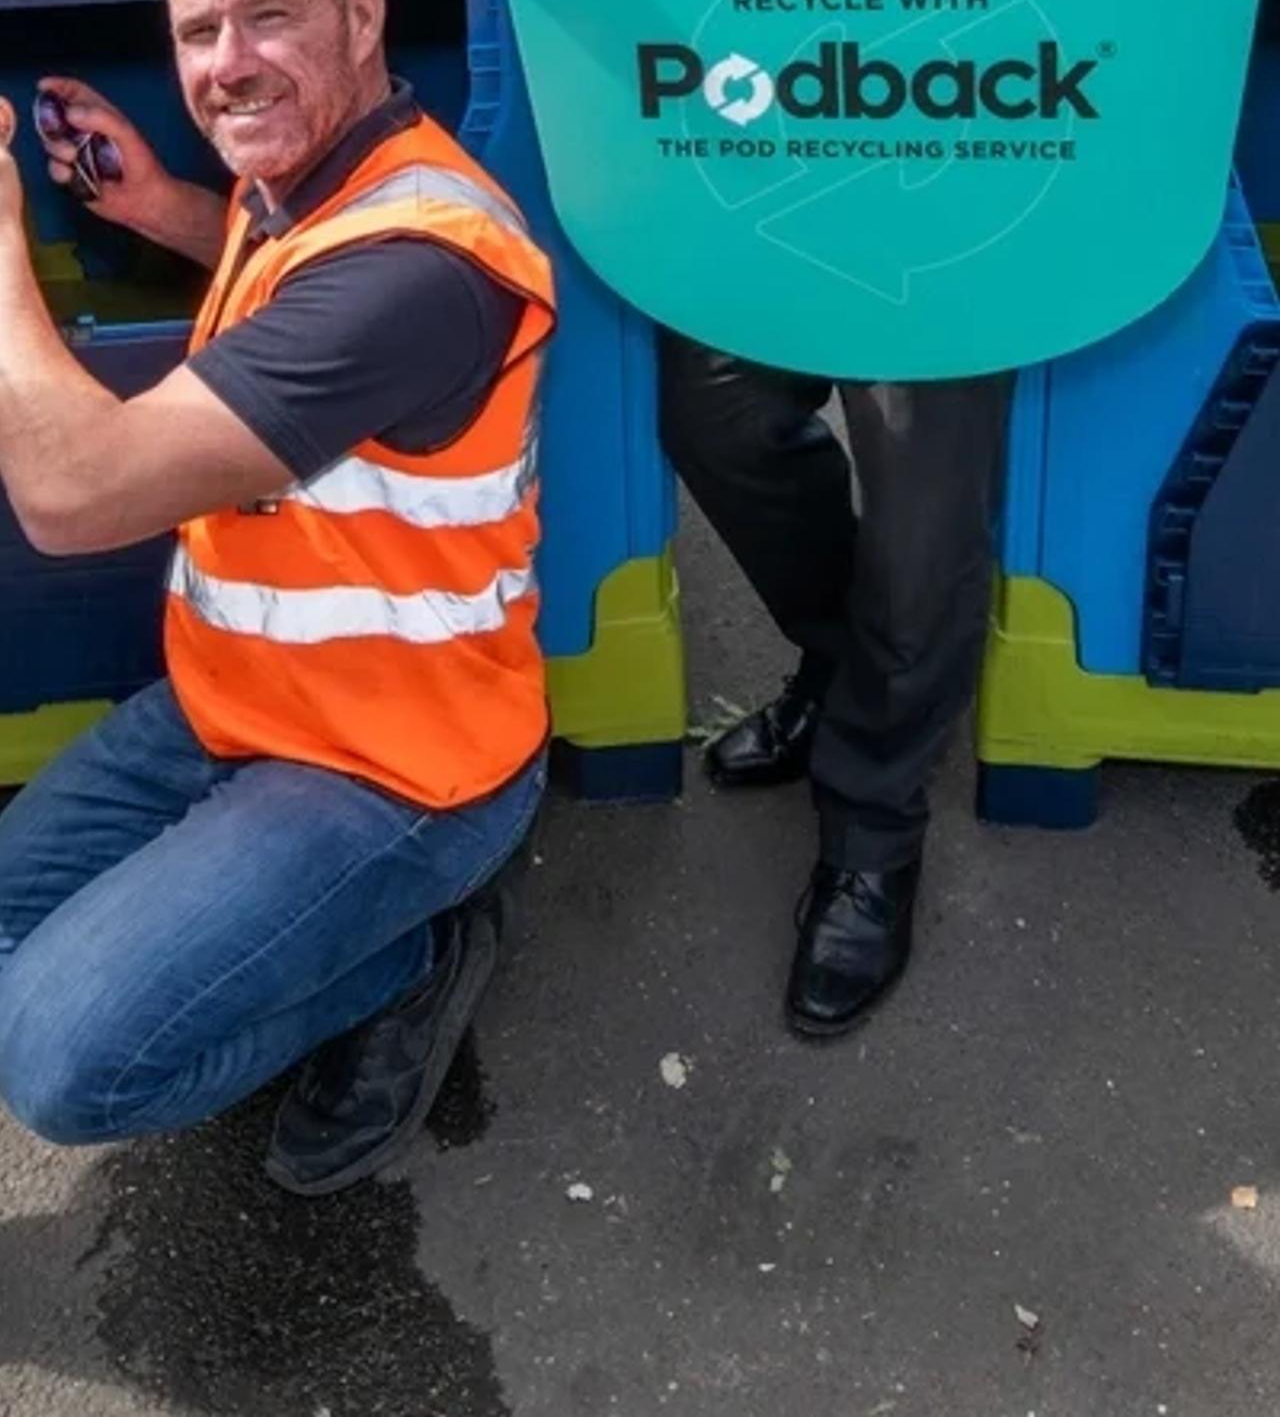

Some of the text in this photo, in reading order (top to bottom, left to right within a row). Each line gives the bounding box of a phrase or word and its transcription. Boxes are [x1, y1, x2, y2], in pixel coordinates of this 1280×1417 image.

[657, 138, 1077, 161] THE POD RECYCLING SERVICE
